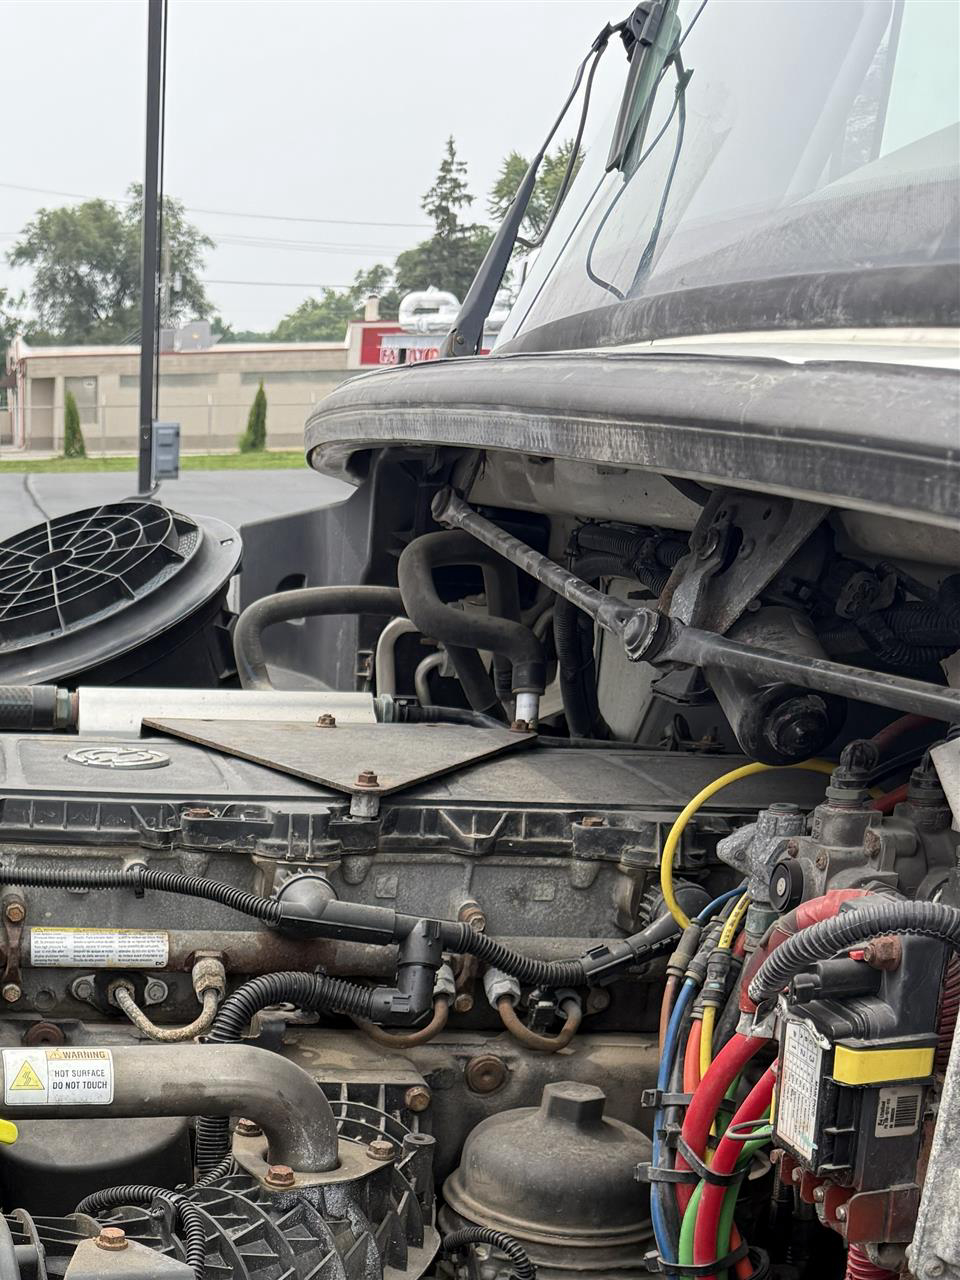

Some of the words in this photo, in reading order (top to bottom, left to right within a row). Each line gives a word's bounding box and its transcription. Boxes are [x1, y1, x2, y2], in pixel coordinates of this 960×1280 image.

[62, 1051, 106, 1059] WARNING
[71, 1069, 105, 1077] SURFACE
[52, 1082, 63, 1090] DO
[65, 1081, 80, 1089] NOT
[83, 1081, 108, 1089] TOUCH
